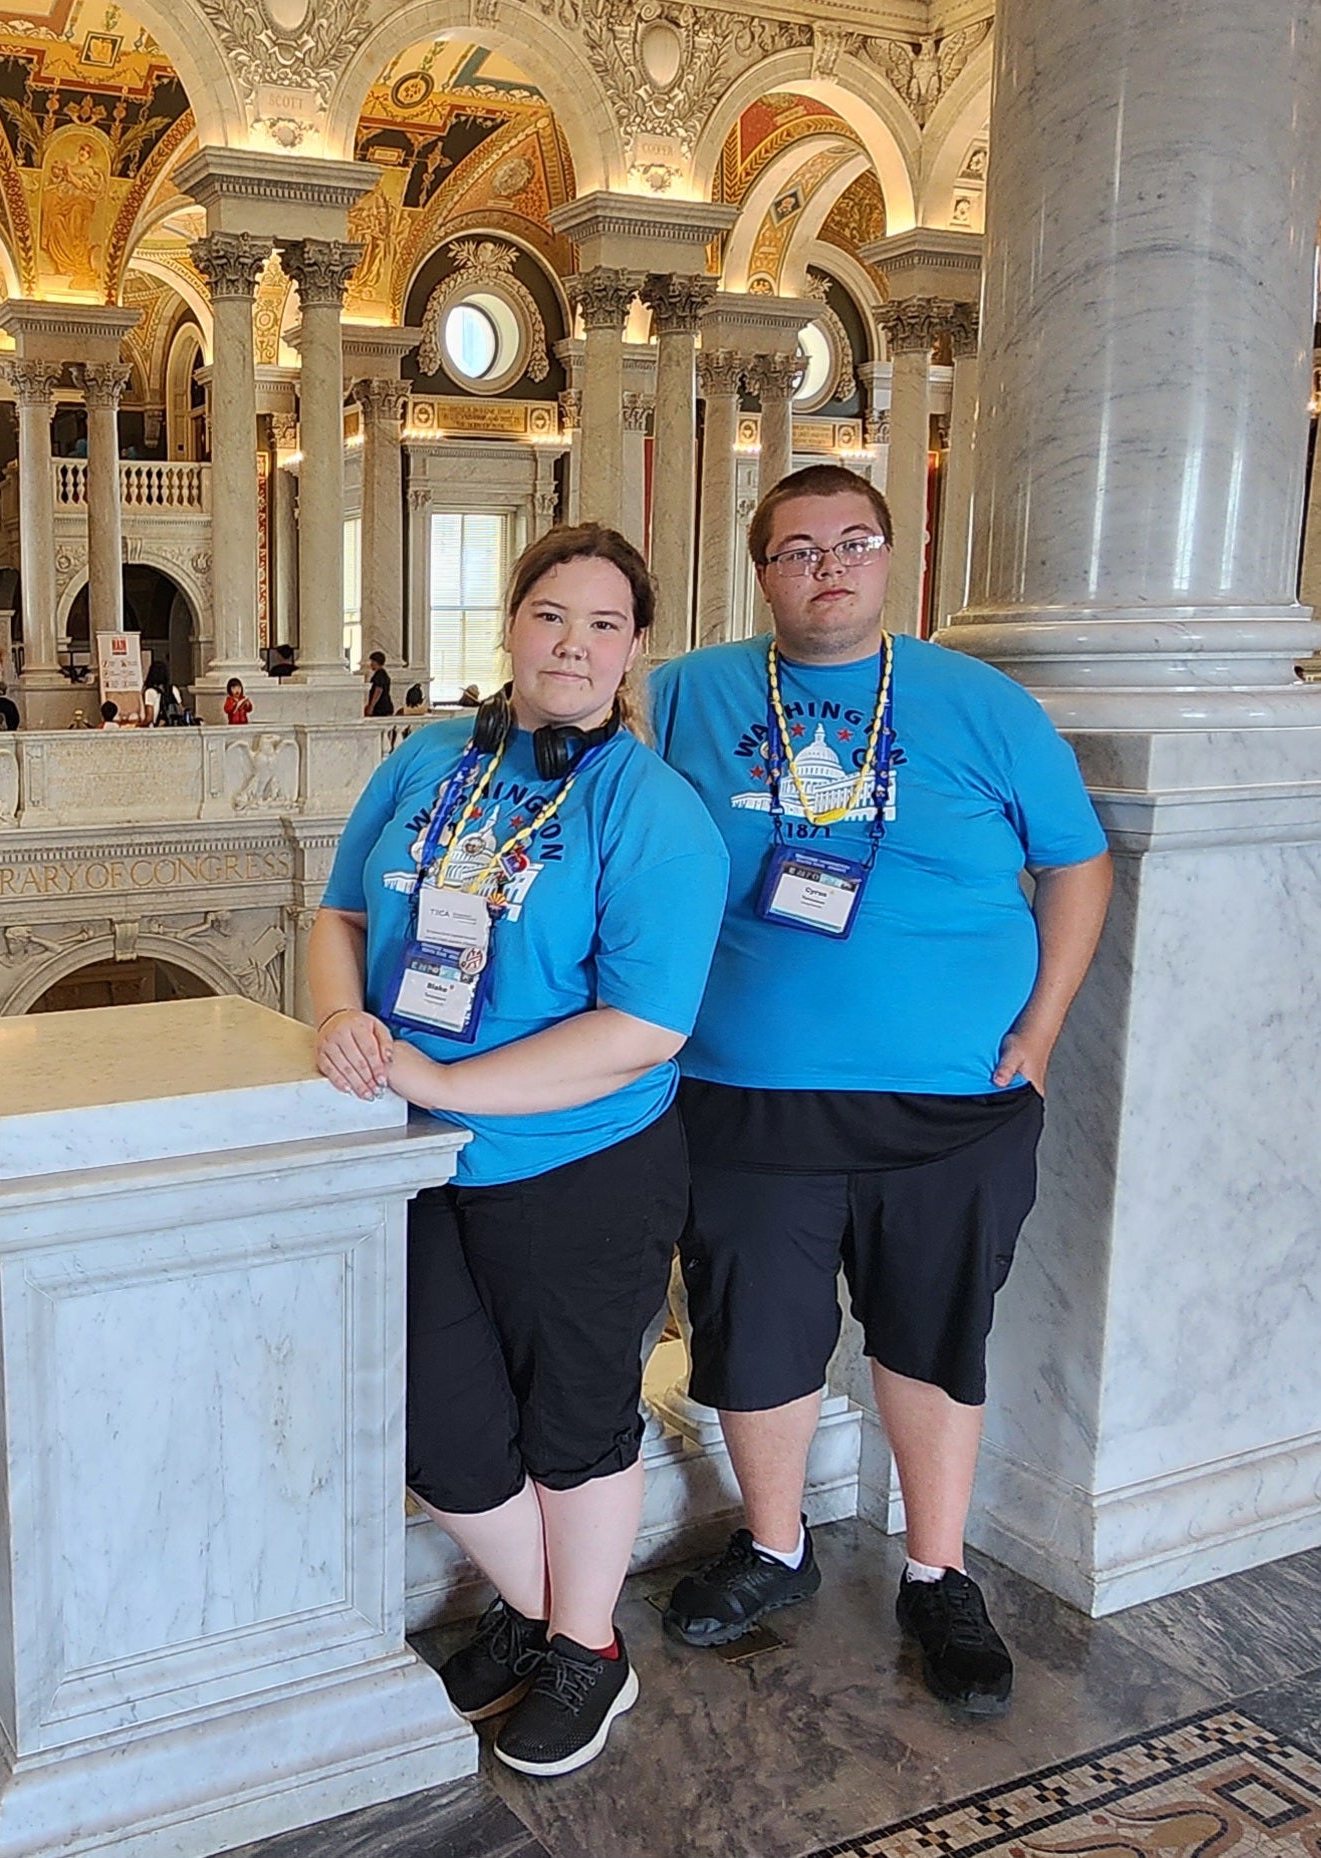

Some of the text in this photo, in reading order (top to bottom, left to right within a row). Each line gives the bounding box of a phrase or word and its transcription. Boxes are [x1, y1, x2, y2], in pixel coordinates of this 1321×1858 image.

[268, 92, 304, 110] SCOTT
[787, 821, 831, 840] 1871
[86, 861, 125, 890] OF
[130, 852, 291, 887] CONGRESS
[427, 982, 448, 993] Blake
